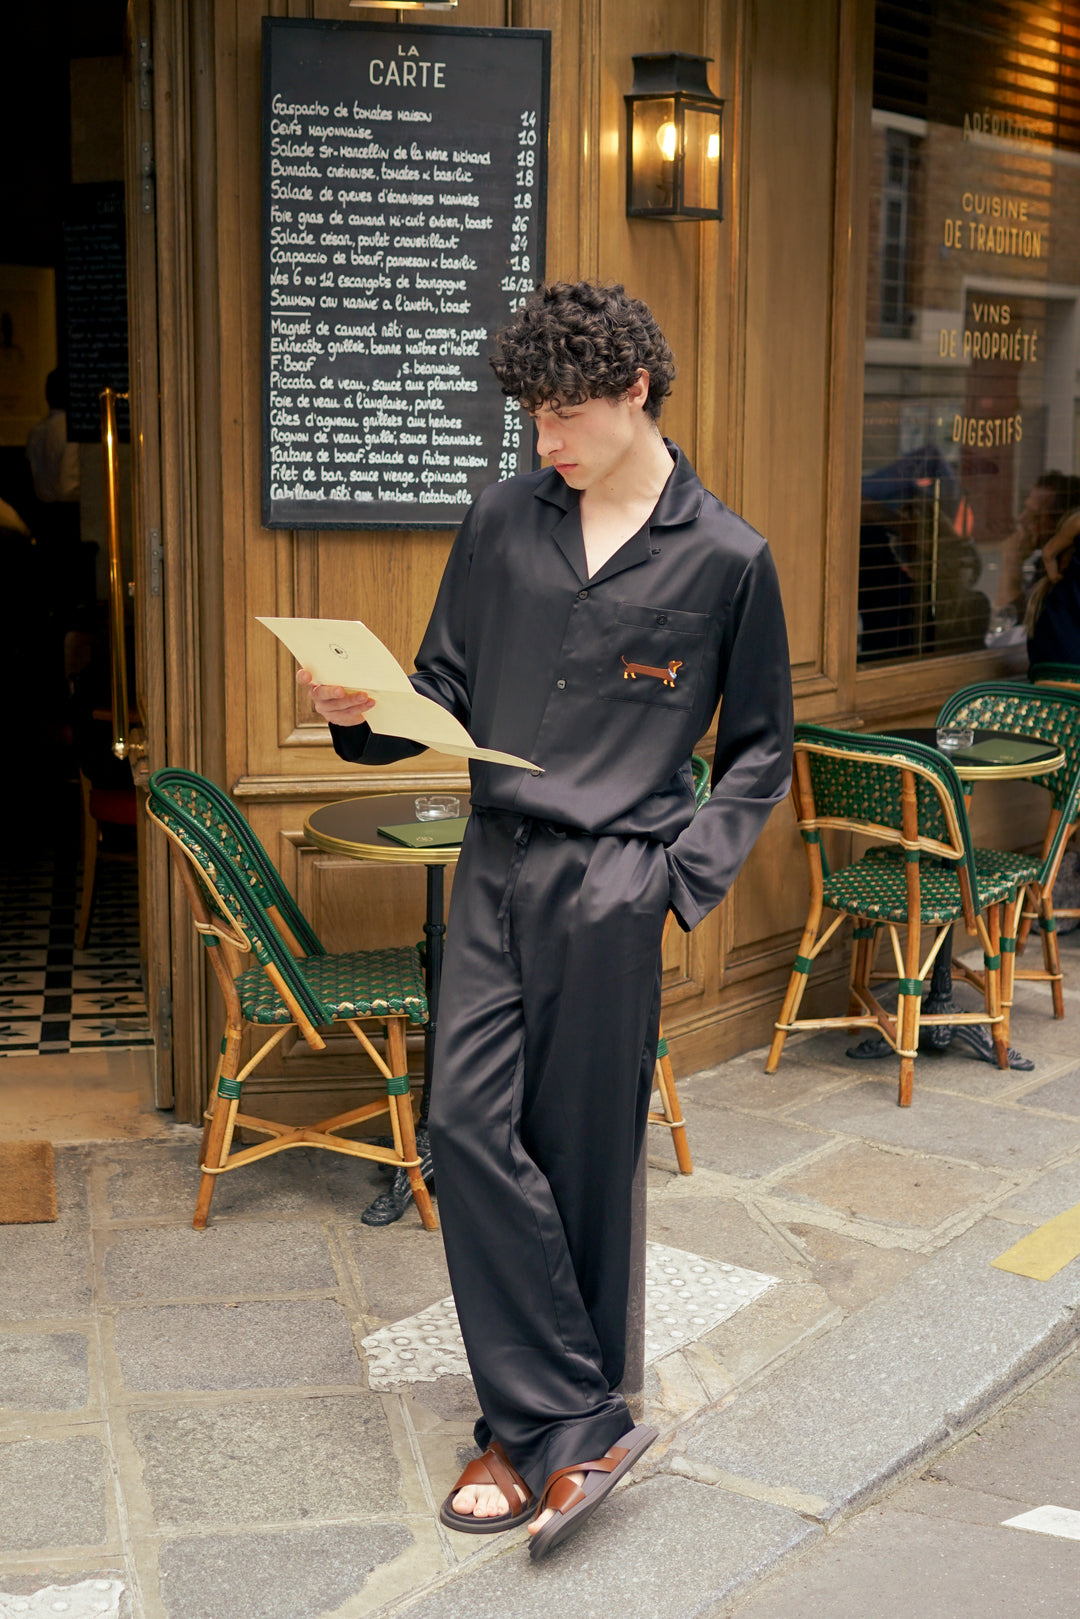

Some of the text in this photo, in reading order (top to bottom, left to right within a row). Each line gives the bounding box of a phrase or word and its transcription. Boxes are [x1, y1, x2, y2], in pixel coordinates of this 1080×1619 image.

[398, 45, 419, 57] LA
[369, 59, 446, 88] CARTE
[271, 93, 330, 120] Gaspacho
[333, 102, 349, 117] de
[353, 100, 393, 120] tomates
[520, 110, 537, 127] 14
[308, 126, 373, 142] mayonnaise
[518, 130, 537, 145] 10
[270, 138, 315, 157] Salade
[393, 145, 408, 160] de
[410, 142, 423, 160] la
[517, 150, 535, 167] 18
[271, 159, 322, 177] Burrata
[381, 161, 420, 180] tomates
[433, 164, 474, 183] basilic
[515, 169, 534, 187] 18
[271, 180, 313, 200] Salade
[319, 186, 334, 202] de
[337, 190, 372, 209] queues
[513, 192, 533, 209] 18
[962, 191, 1028, 221] CUISINE
[271, 205, 293, 223] Foie
[298, 212, 324, 230] gras
[329, 209, 344, 225] de
[348, 213, 385, 226] canard
[464, 213, 493, 230] toast
[511, 215, 530, 233] 26
[270, 226, 316, 245] Salade
[357, 231, 390, 254] poulet
[393, 232, 460, 249] croustillant
[510, 234, 528, 252] 24
[945, 219, 1041, 258] DE TRADITION
[270, 246, 328, 270] Carpaccio
[332, 251, 347, 265] de
[440, 252, 478, 271] basilic
[510, 255, 531, 273] 18
[293, 266, 302, 286] 6
[304, 275, 317, 286] ou
[319, 271, 335, 288] 12
[395, 273, 410, 289] de
[415, 271, 467, 296] bourgogne
[501, 276, 535, 293] 16/32
[270, 288, 316, 308] Saumon
[320, 295, 338, 309] cru
[440, 297, 471, 314] toast
[973, 302, 1010, 325] VINS
[271, 318, 312, 341] Magret
[315, 321, 330, 336] de
[334, 322, 377, 337] canard
[406, 327, 422, 340] au
[370, 337, 402, 355] beurre
[939, 328, 1038, 362] DE PROPRIÉTÉ
[270, 371, 316, 389] Piccata
[320, 376, 334, 389] de
[372, 379, 402, 391] sauce
[405, 380, 425, 391] aux
[427, 375, 478, 397] pleurotes
[270, 391, 293, 408] Foie
[297, 393, 310, 408] de
[313, 396, 340, 408] veau
[406, 416, 426, 428] aux
[428, 412, 462, 429] herbes
[504, 414, 523, 430] 31
[953, 414, 1022, 447] DIGESTIFS
[271, 427, 309, 446] Rognon
[314, 431, 328, 443] de
[333, 433, 362, 444] veau
[399, 432, 427, 444] sauce
[502, 432, 520, 448] 29
[270, 445, 313, 462] Tartare
[316, 448, 330, 463] de
[368, 450, 404, 464] salade
[407, 454, 419, 464] ou
[422, 449, 450, 465] frites
[453, 455, 488, 467] maison
[498, 452, 517, 470] 28
[271, 464, 299, 481] Filet
[302, 467, 317, 482] de
[350, 470, 379, 482] sauce
[270, 483, 327, 501] Cabillaud
[354, 490, 374, 502] aux
[419, 488, 473, 505] ratatouille
